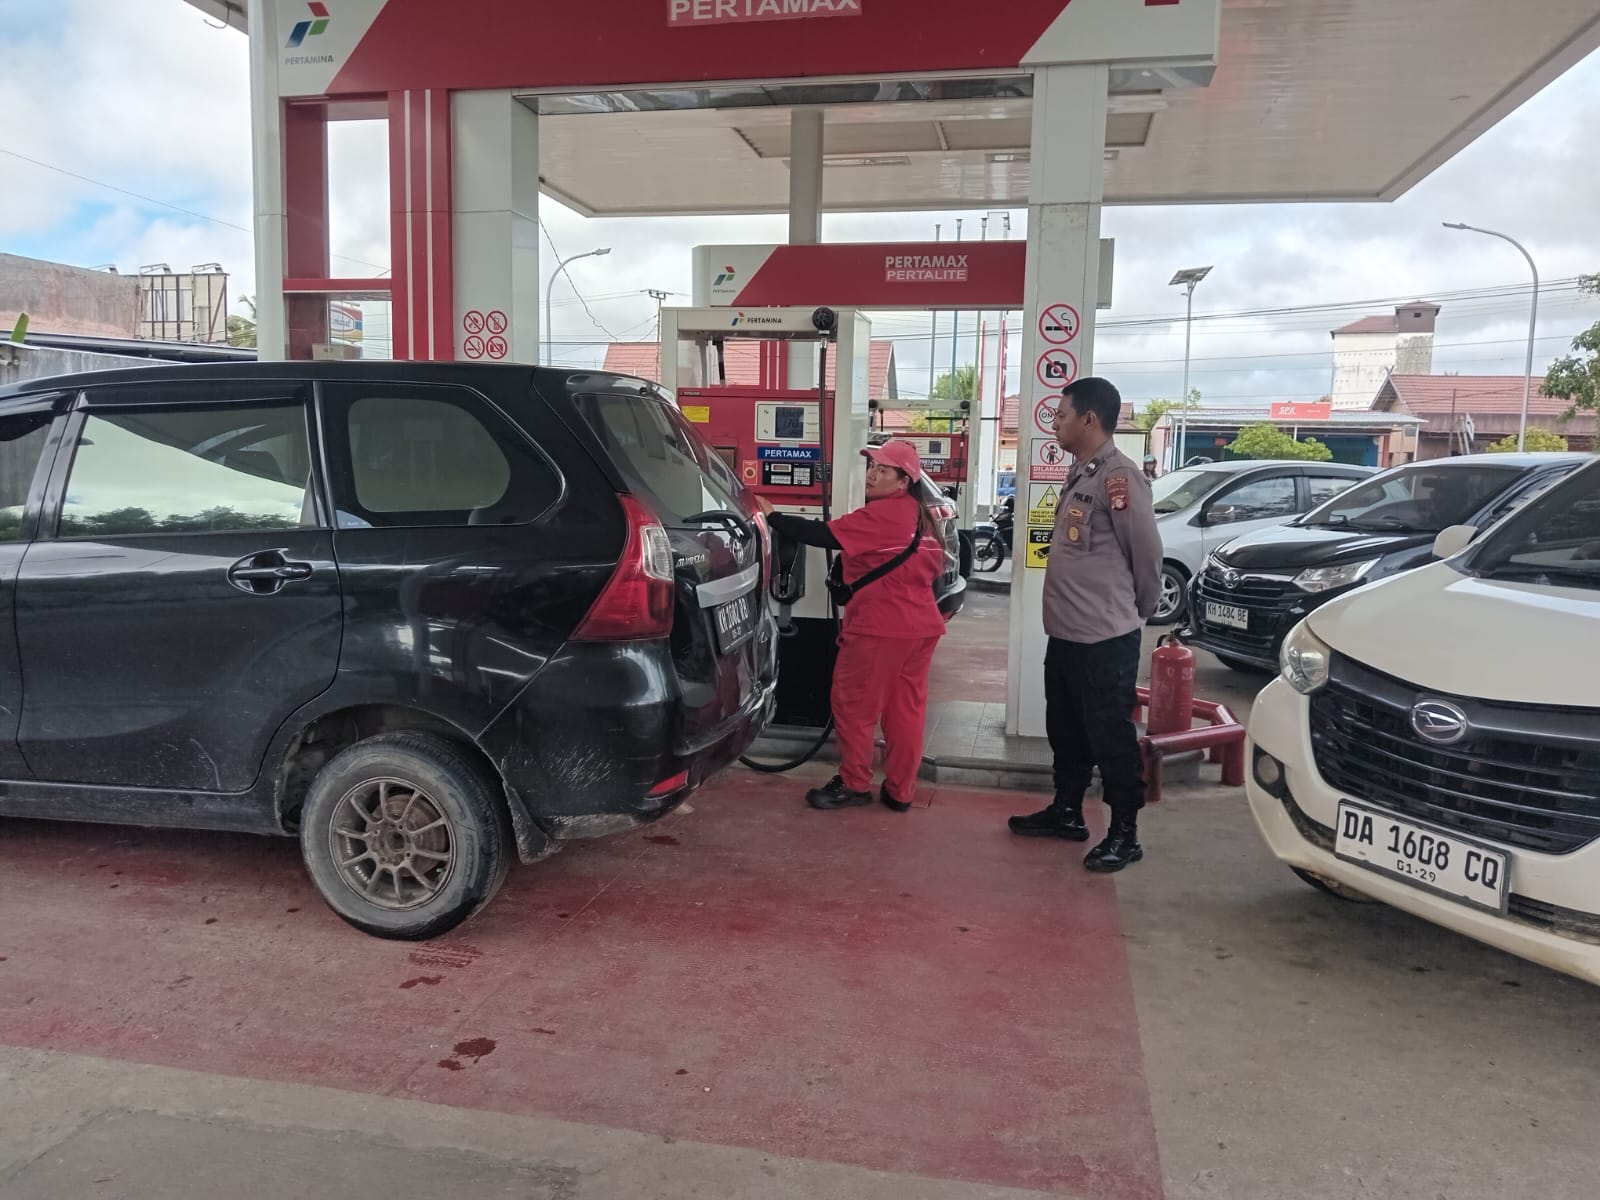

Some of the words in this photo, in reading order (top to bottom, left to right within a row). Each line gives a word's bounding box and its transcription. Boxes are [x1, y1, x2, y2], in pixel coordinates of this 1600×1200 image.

[284, 55, 334, 65] PERTAMINA
[885, 255, 968, 268] PERTAMAX
[886, 269, 967, 280] PERTALITE
[764, 449, 812, 458] PERTAMAX
[1208, 604, 1217, 616] KH
[1218, 606, 1235, 619] 1484
[1238, 610, 1247, 622] BE
[1343, 810, 1373, 846] DA
[1387, 825, 1450, 871] 1608
[1464, 850, 1499, 890] CQ
